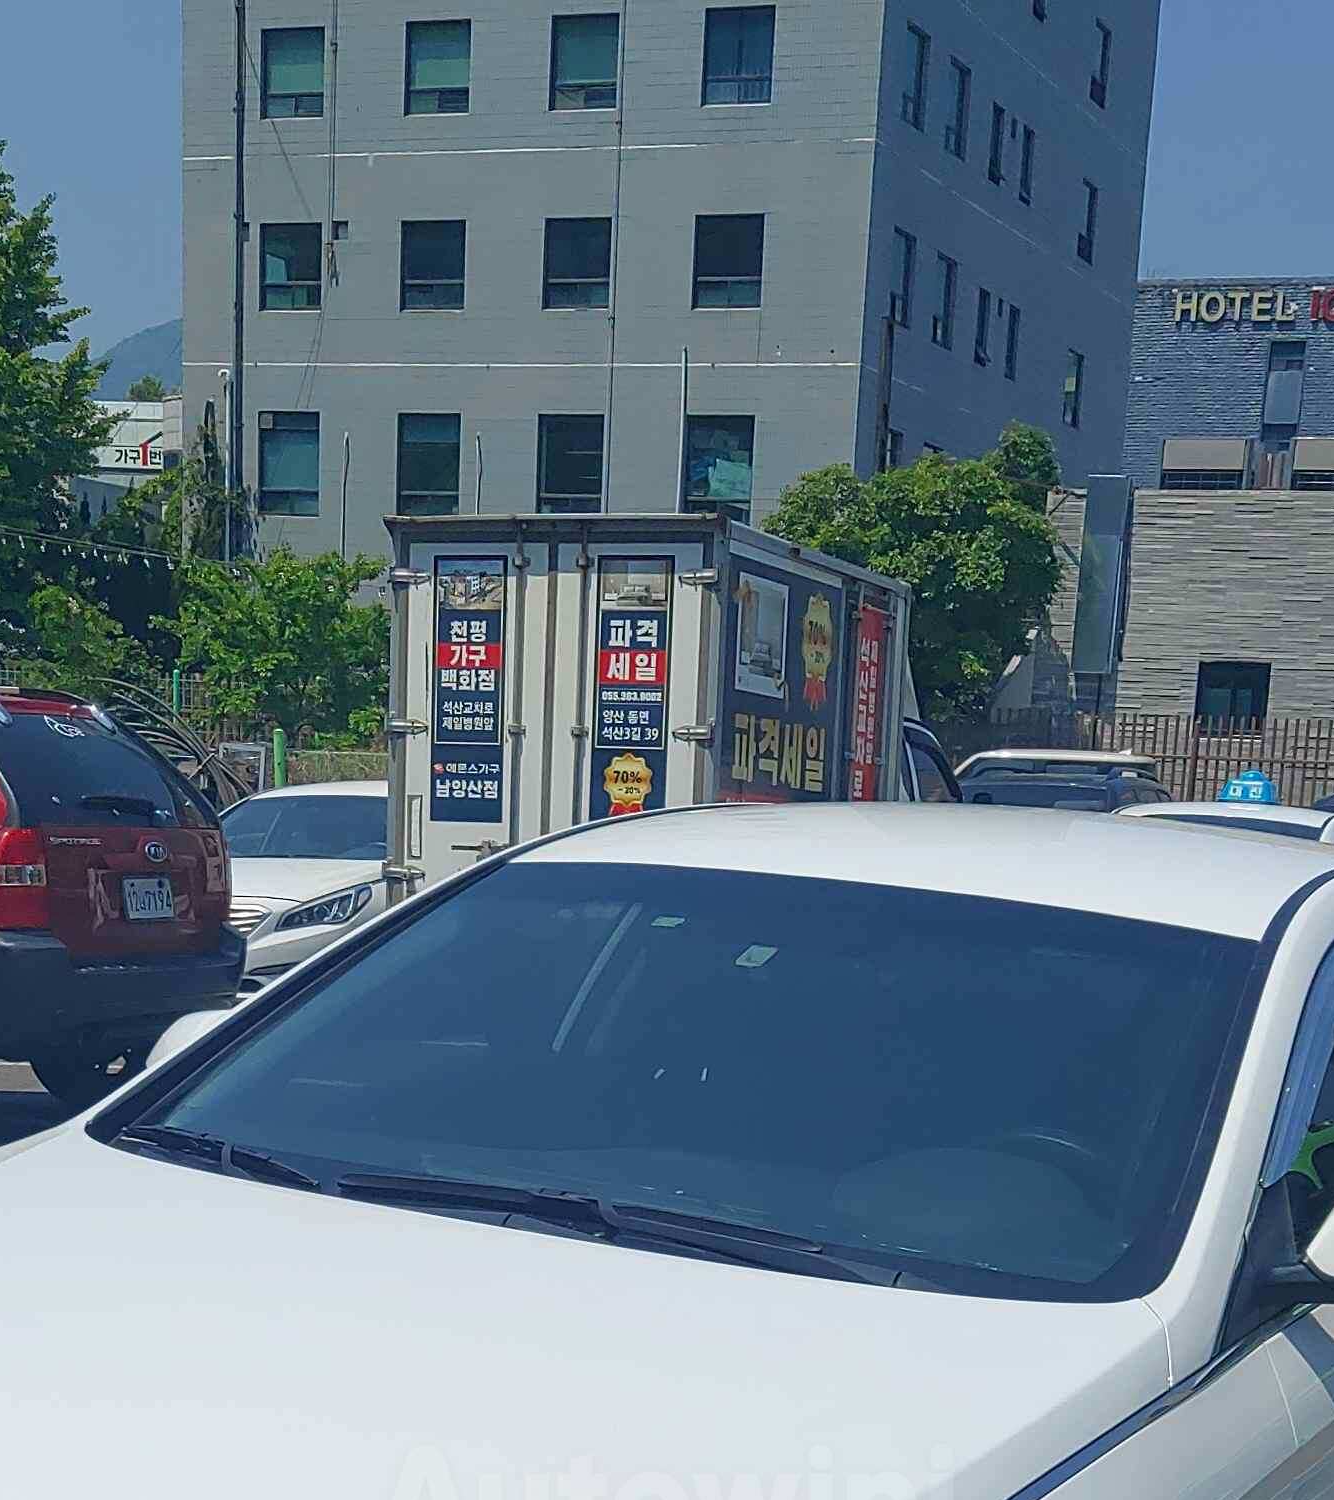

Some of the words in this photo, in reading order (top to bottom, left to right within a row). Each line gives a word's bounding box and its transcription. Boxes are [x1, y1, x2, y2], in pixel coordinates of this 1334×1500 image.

[1173, 289, 1295, 322] HOTEL
[608, 620, 658, 648] 파격
[450, 645, 487, 667] 가구
[606, 652, 657, 681] 세일
[441, 669, 495, 691] 백화점
[442, 701, 495, 716] 석산교차로
[602, 710, 624, 724] 양산
[442, 716, 494, 731] 제일병원앞
[602, 727, 641, 740] 석산3길
[644, 728, 659, 740] 39
[731, 713, 826, 793] 파격세일
[613, 770, 643, 784] 70%
[435, 779, 498, 799] 남양산점
